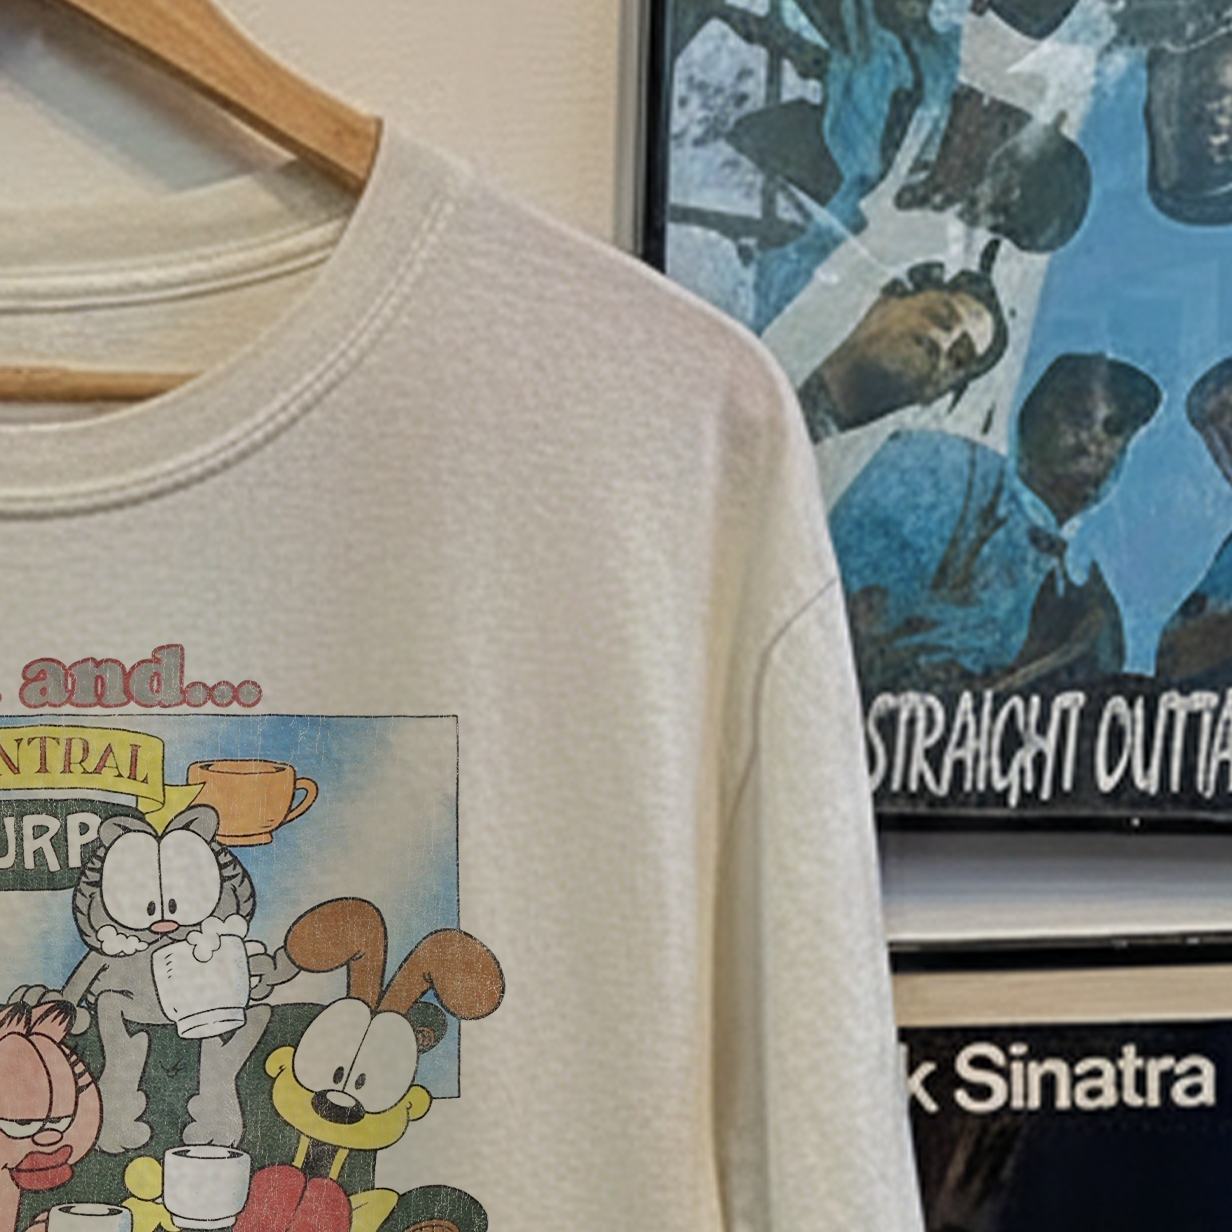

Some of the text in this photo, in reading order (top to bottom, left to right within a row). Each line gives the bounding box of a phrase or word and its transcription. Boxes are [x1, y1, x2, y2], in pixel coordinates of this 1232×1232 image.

[20, 643, 263, 709] and...
[867, 690, 1086, 808] STRAIGHT
[954, 1042, 1217, 1113] Sinatra
